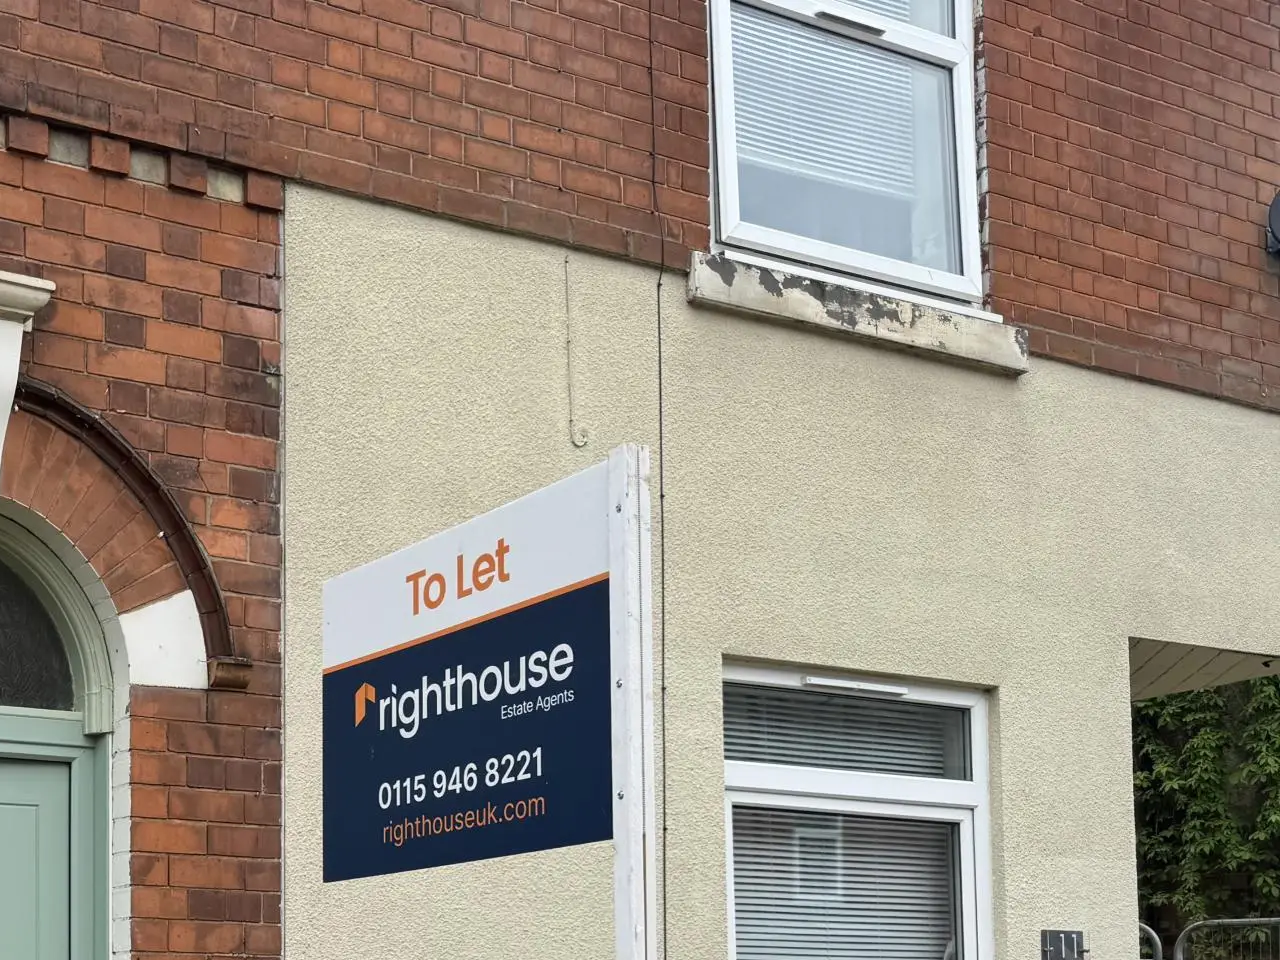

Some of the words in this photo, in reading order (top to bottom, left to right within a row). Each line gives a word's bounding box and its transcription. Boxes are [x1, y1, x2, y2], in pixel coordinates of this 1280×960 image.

[406, 568, 446, 616] To
[457, 538, 510, 600] Let
[379, 643, 574, 739] righthouse
[501, 700, 533, 720] Estate
[535, 689, 575, 712] Agents
[378, 774, 427, 810] 0115
[432, 762, 478, 798] 946
[484, 747, 543, 787] 8221
[383, 796, 546, 847] righthouseuk.com
[1060, 933, 1078, 959] 11
